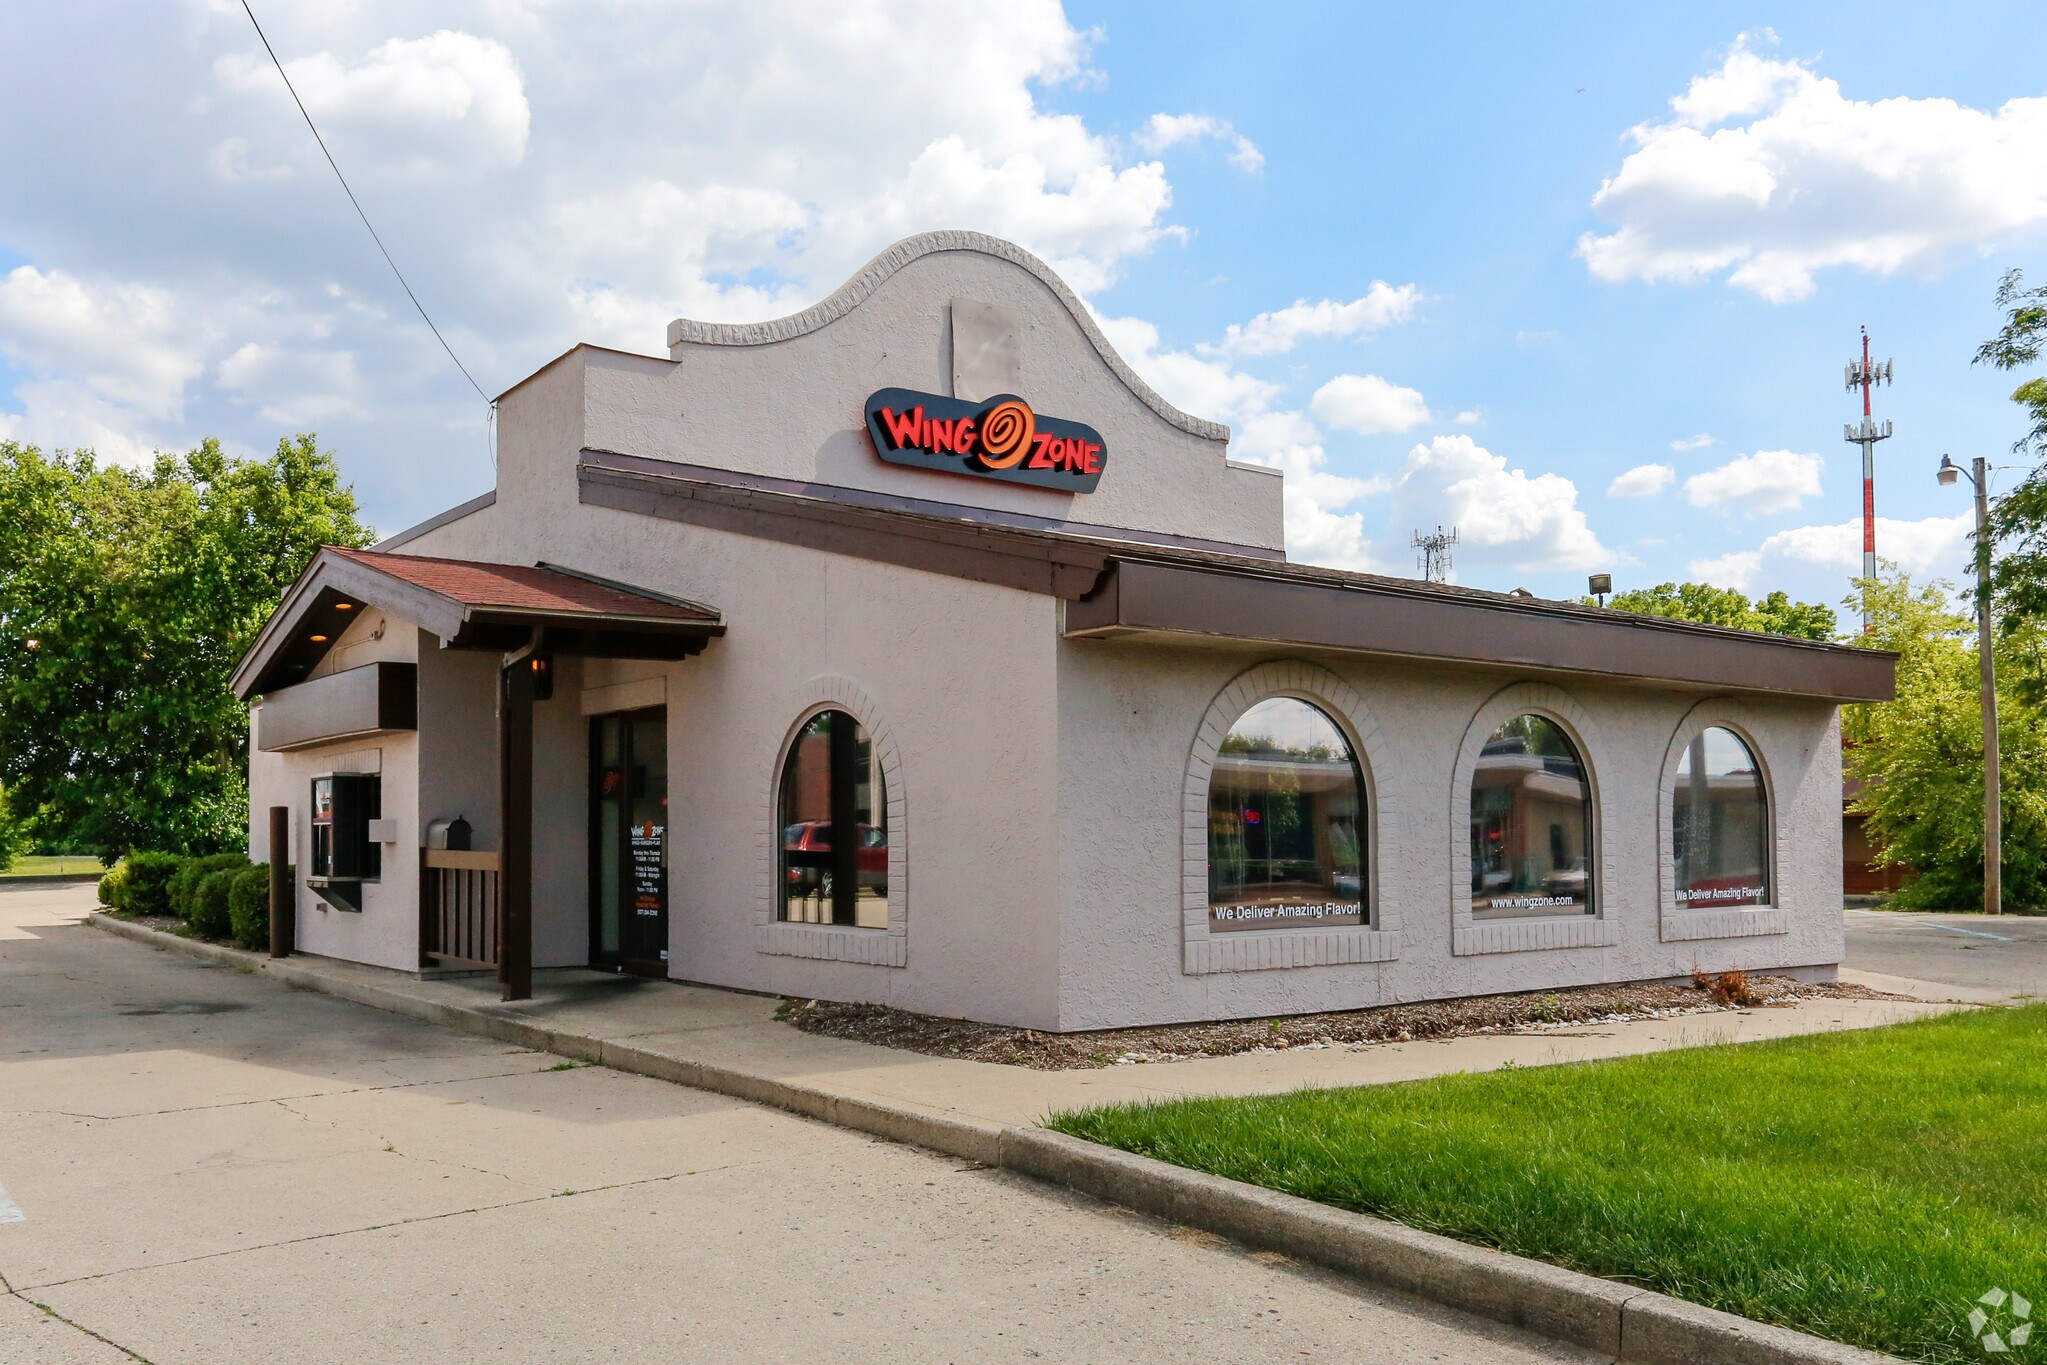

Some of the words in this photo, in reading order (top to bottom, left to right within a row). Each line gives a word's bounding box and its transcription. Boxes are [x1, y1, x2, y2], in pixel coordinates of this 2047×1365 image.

[1028, 432, 1102, 474] ZONE
[1675, 889, 1688, 900] We
[1688, 888, 1712, 900] Deliver
[1712, 887, 1741, 900] Amazing
[1742, 886, 1764, 897] Flavor!
[1215, 906, 1234, 920] We
[1237, 905, 1274, 919] Deliver
[1277, 904, 1323, 919] Amazing
[1325, 901, 1361, 915] Flavor!
[1491, 896, 1573, 909] www.wingzone.com
